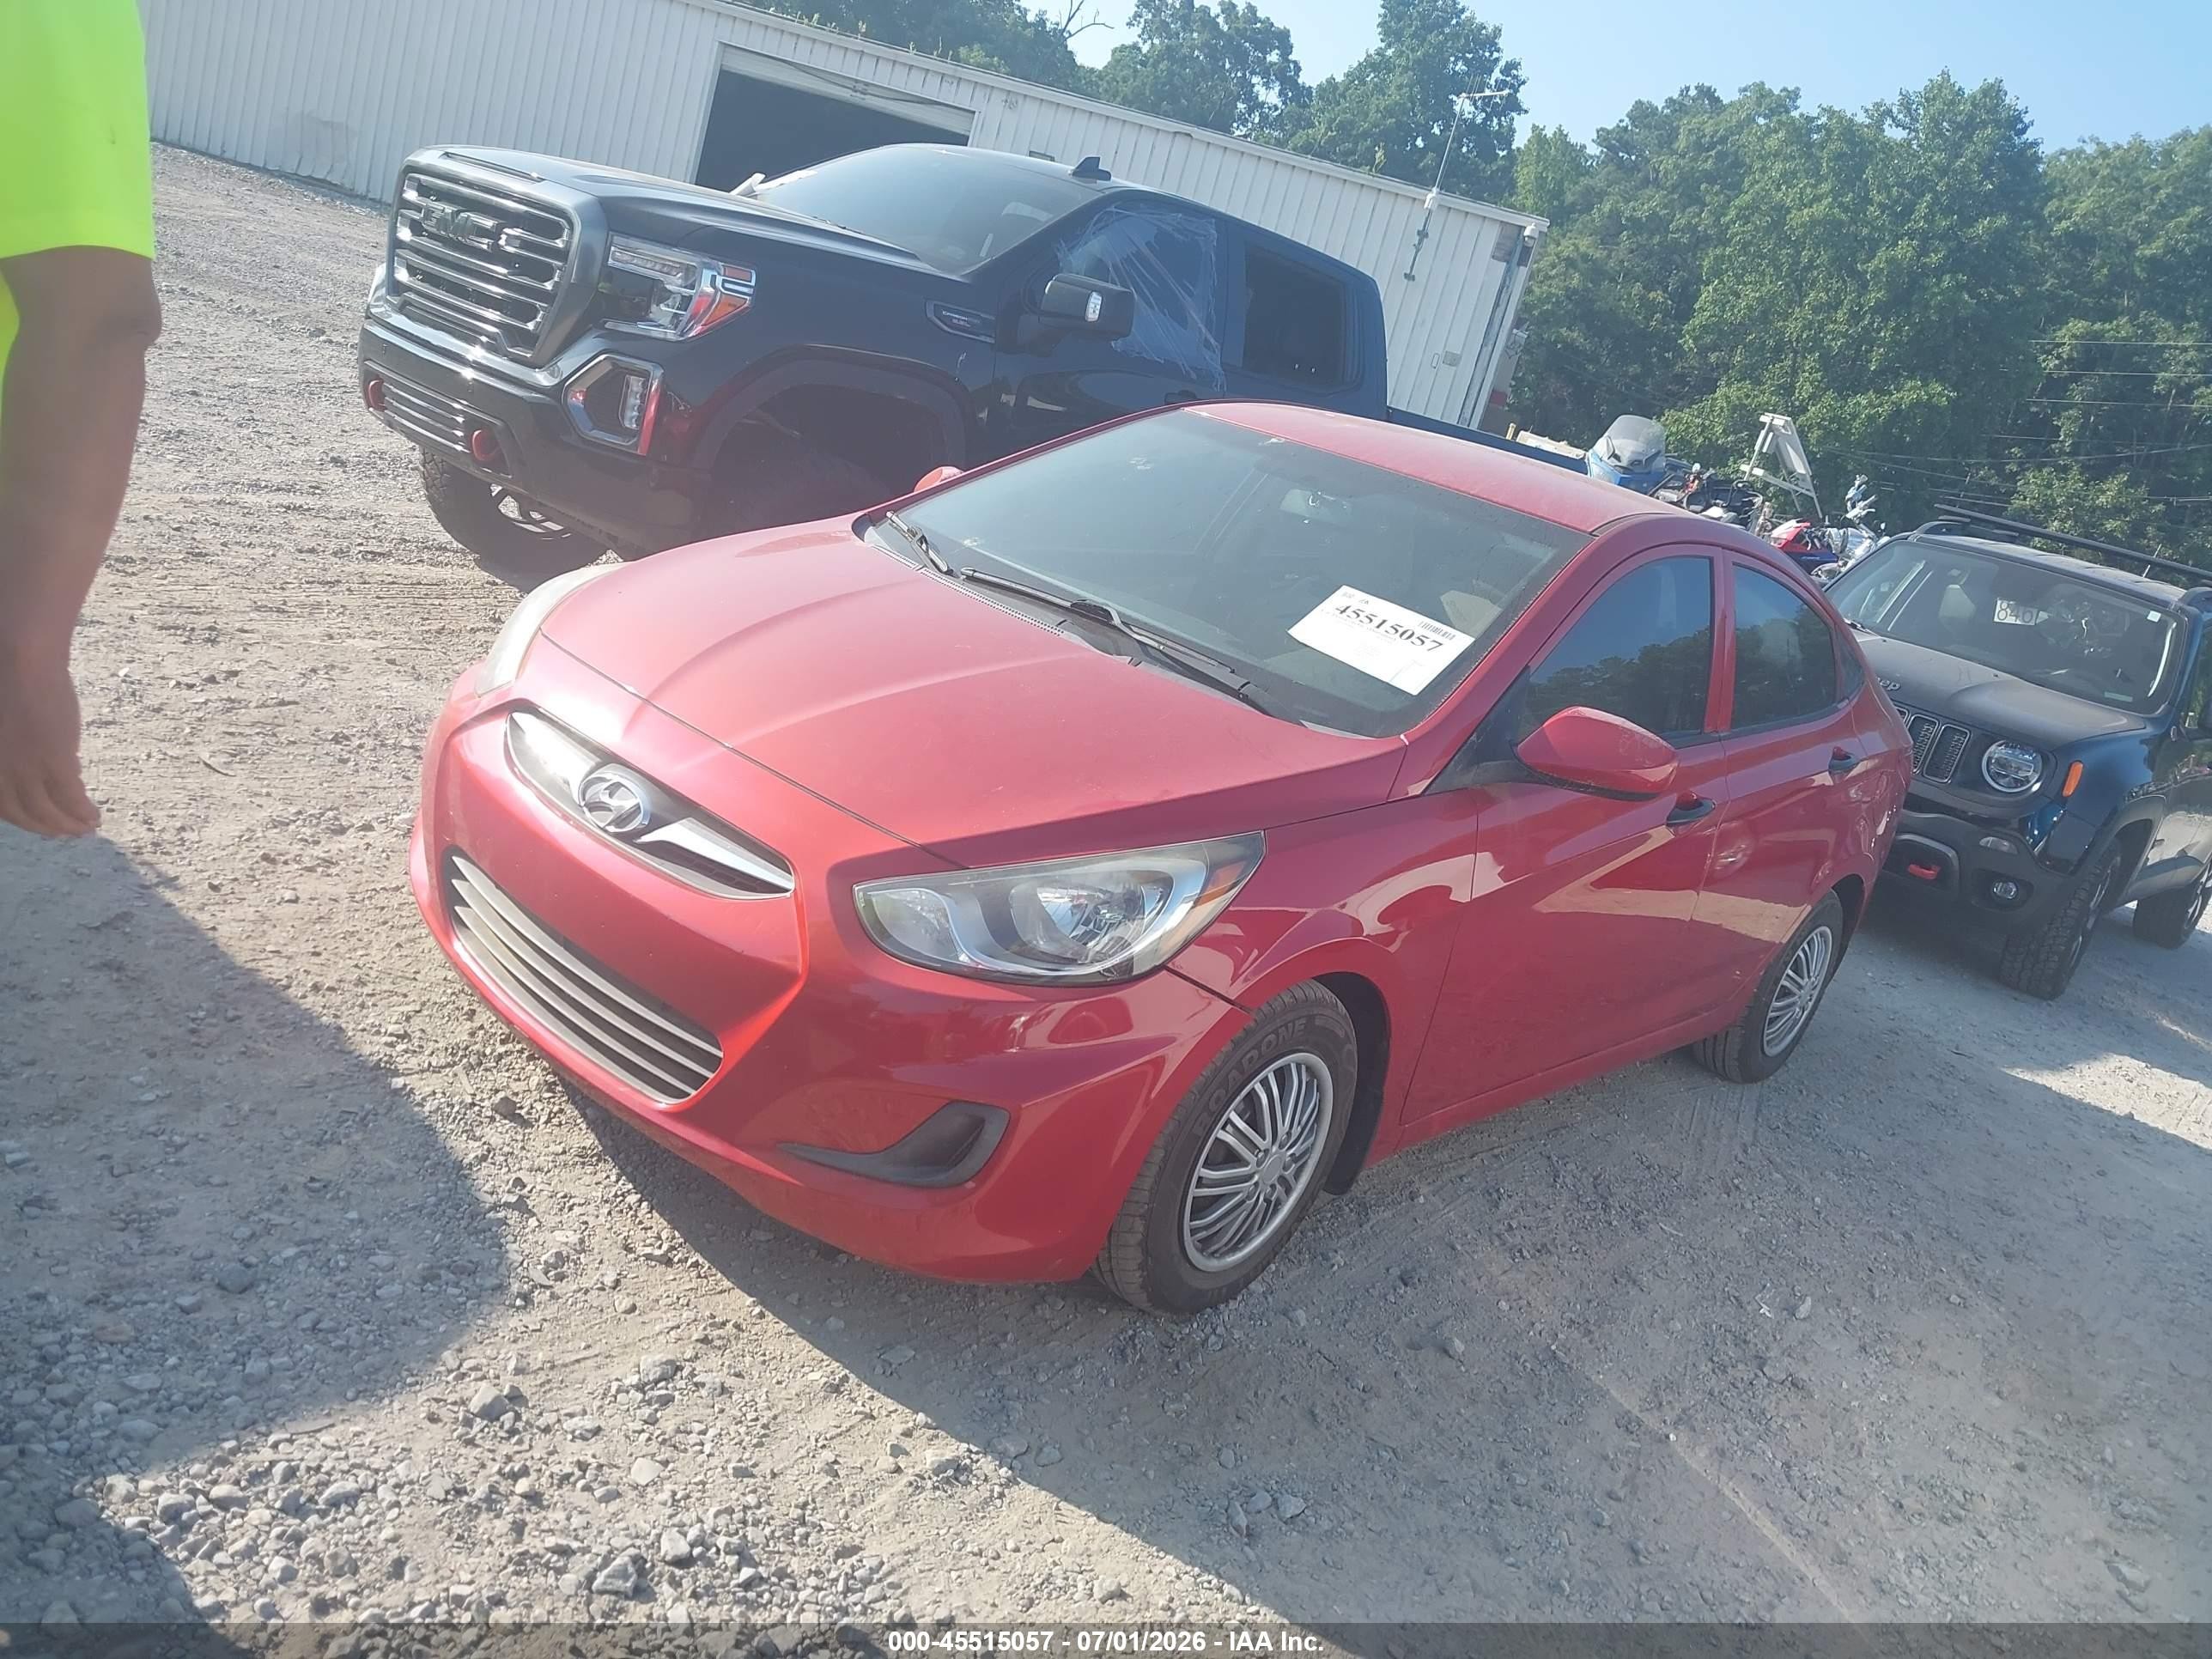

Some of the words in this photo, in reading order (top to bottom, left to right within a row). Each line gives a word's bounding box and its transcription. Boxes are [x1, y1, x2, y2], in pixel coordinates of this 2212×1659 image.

[421, 201, 498, 252] GMC
[1334, 605, 1444, 653] 45515057
[1877, 677, 1901, 691] ep
